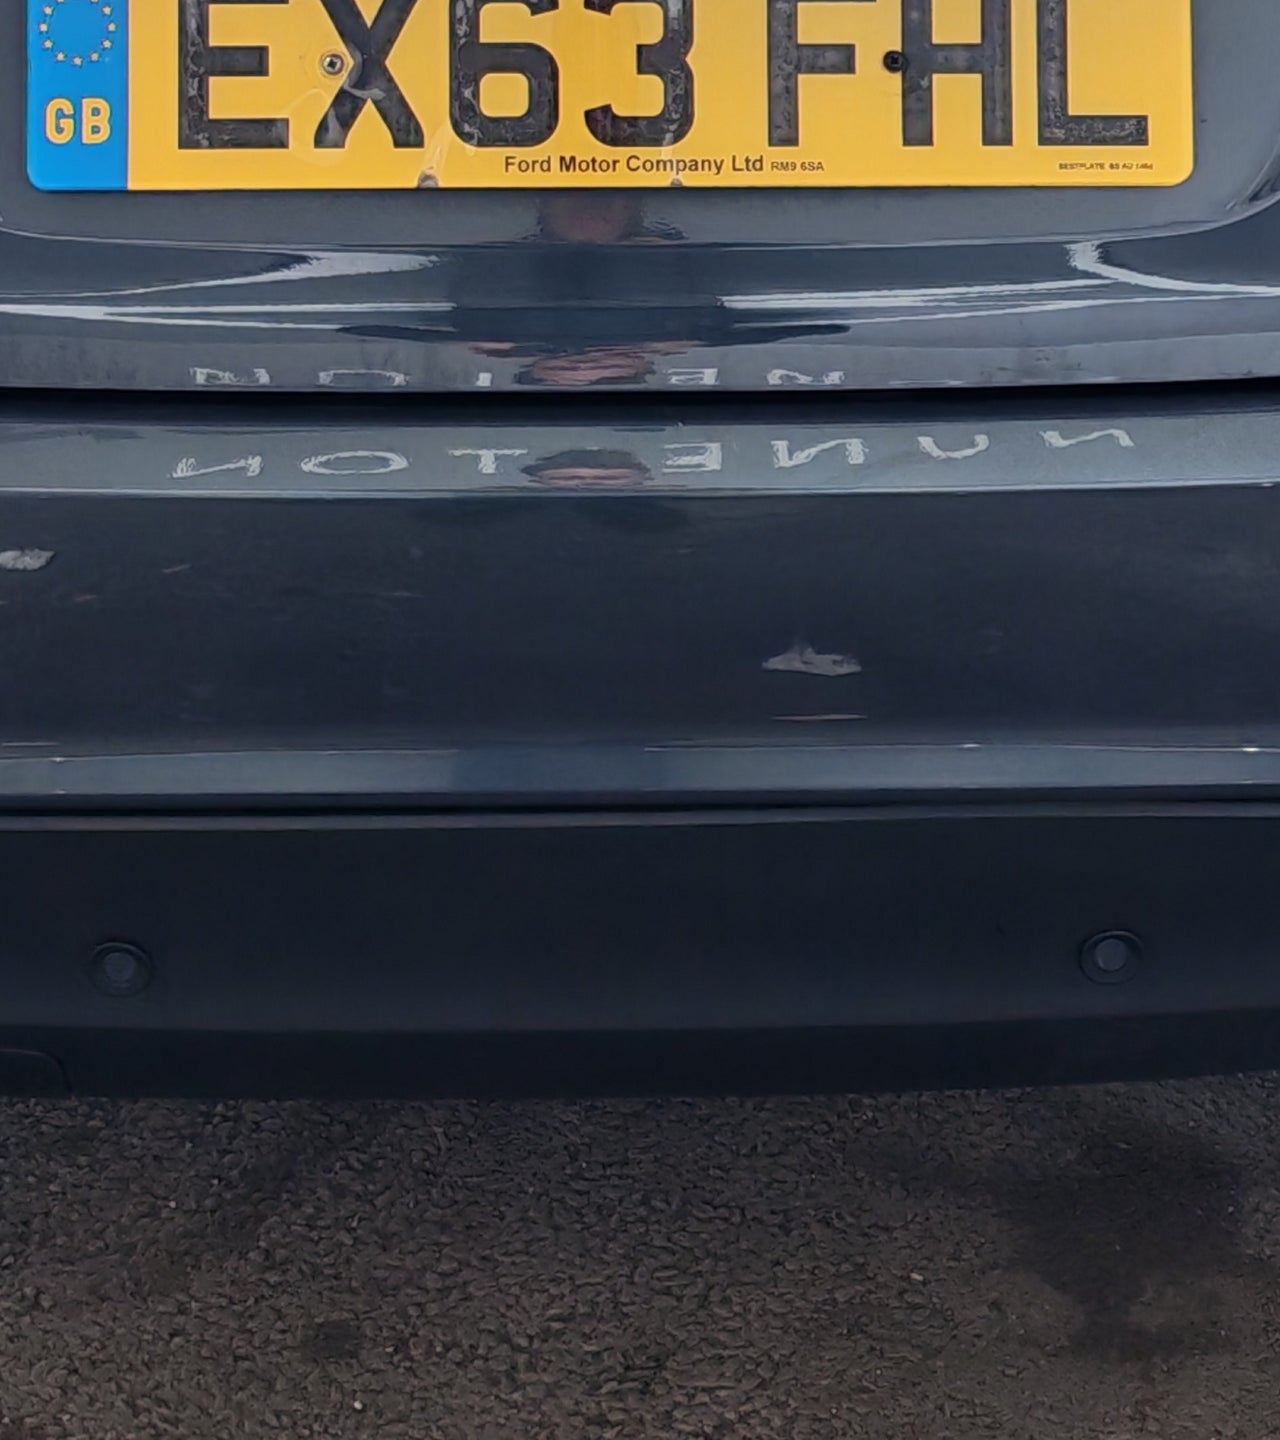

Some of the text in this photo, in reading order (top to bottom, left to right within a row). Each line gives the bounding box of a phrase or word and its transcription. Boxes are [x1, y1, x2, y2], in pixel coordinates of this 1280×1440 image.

[44, 97, 112, 145] GB
[504, 155, 825, 176] Ford Motor Company Ltd RM9 6SA
